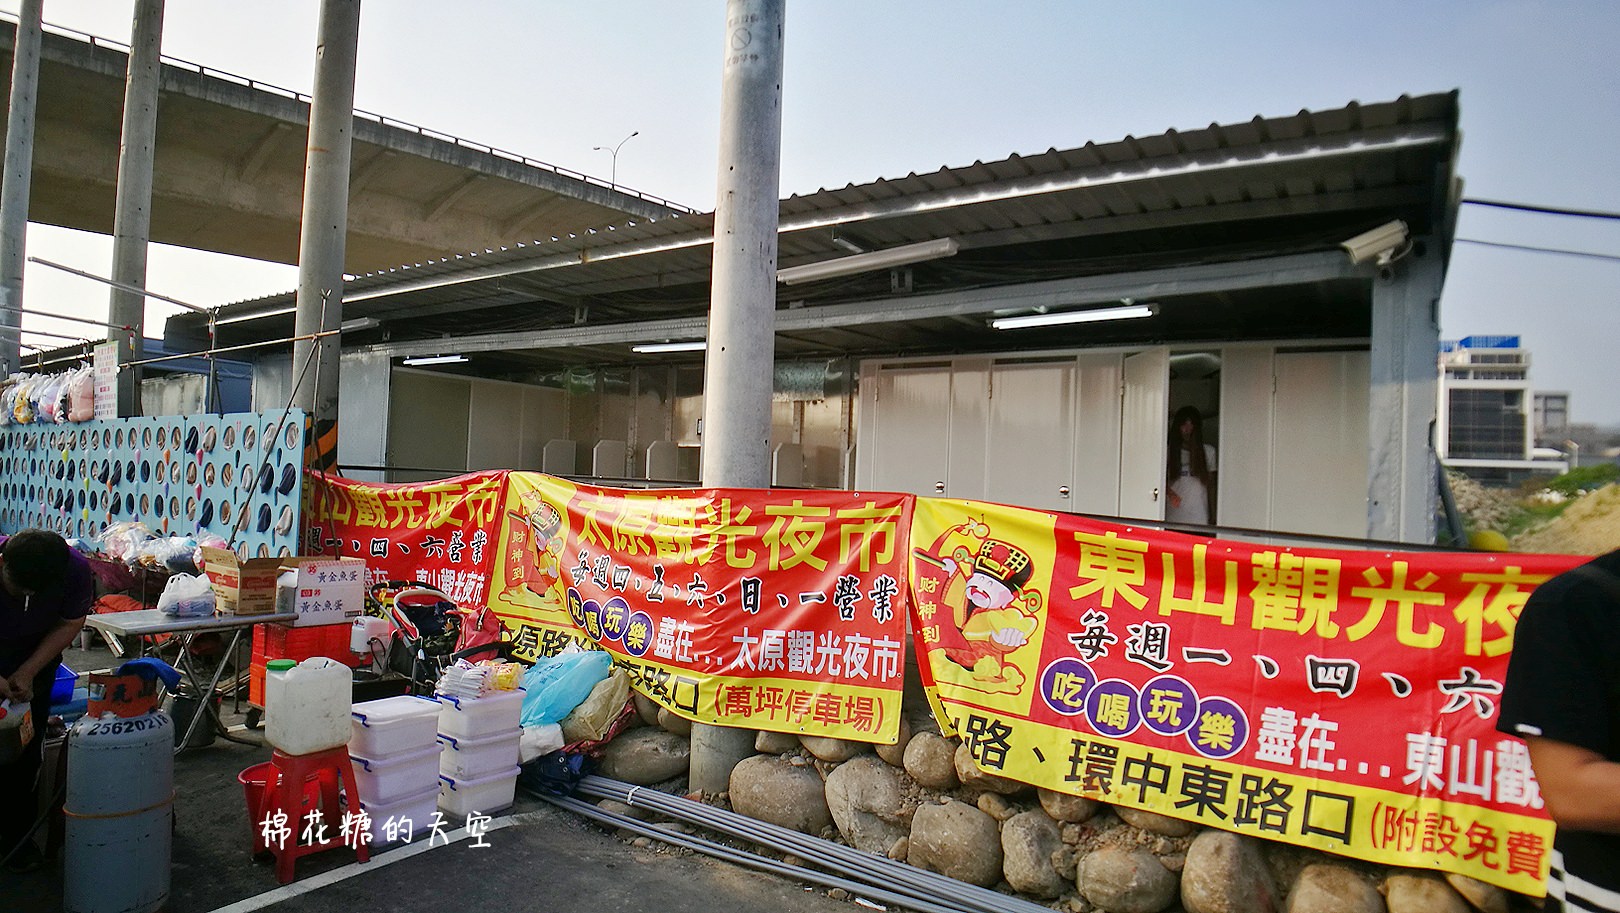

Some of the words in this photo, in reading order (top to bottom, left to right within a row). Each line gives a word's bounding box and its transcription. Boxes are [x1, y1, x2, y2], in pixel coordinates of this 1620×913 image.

[299, 526, 488, 565] 週一、四、六營業
[578, 490, 903, 573] 太原觀光夜市
[569, 595, 648, 650] 吃喝玩樂
[729, 626, 901, 683] 太原觀光夜市
[714, 682, 885, 735] (萬坪停車場)
[1051, 671, 1237, 751] 吃喝玩樂
[1401, 731, 1545, 809] 東山觀
[953, 713, 1356, 846] 路、環中東路口
[1371, 801, 1546, 880] (附設免費
